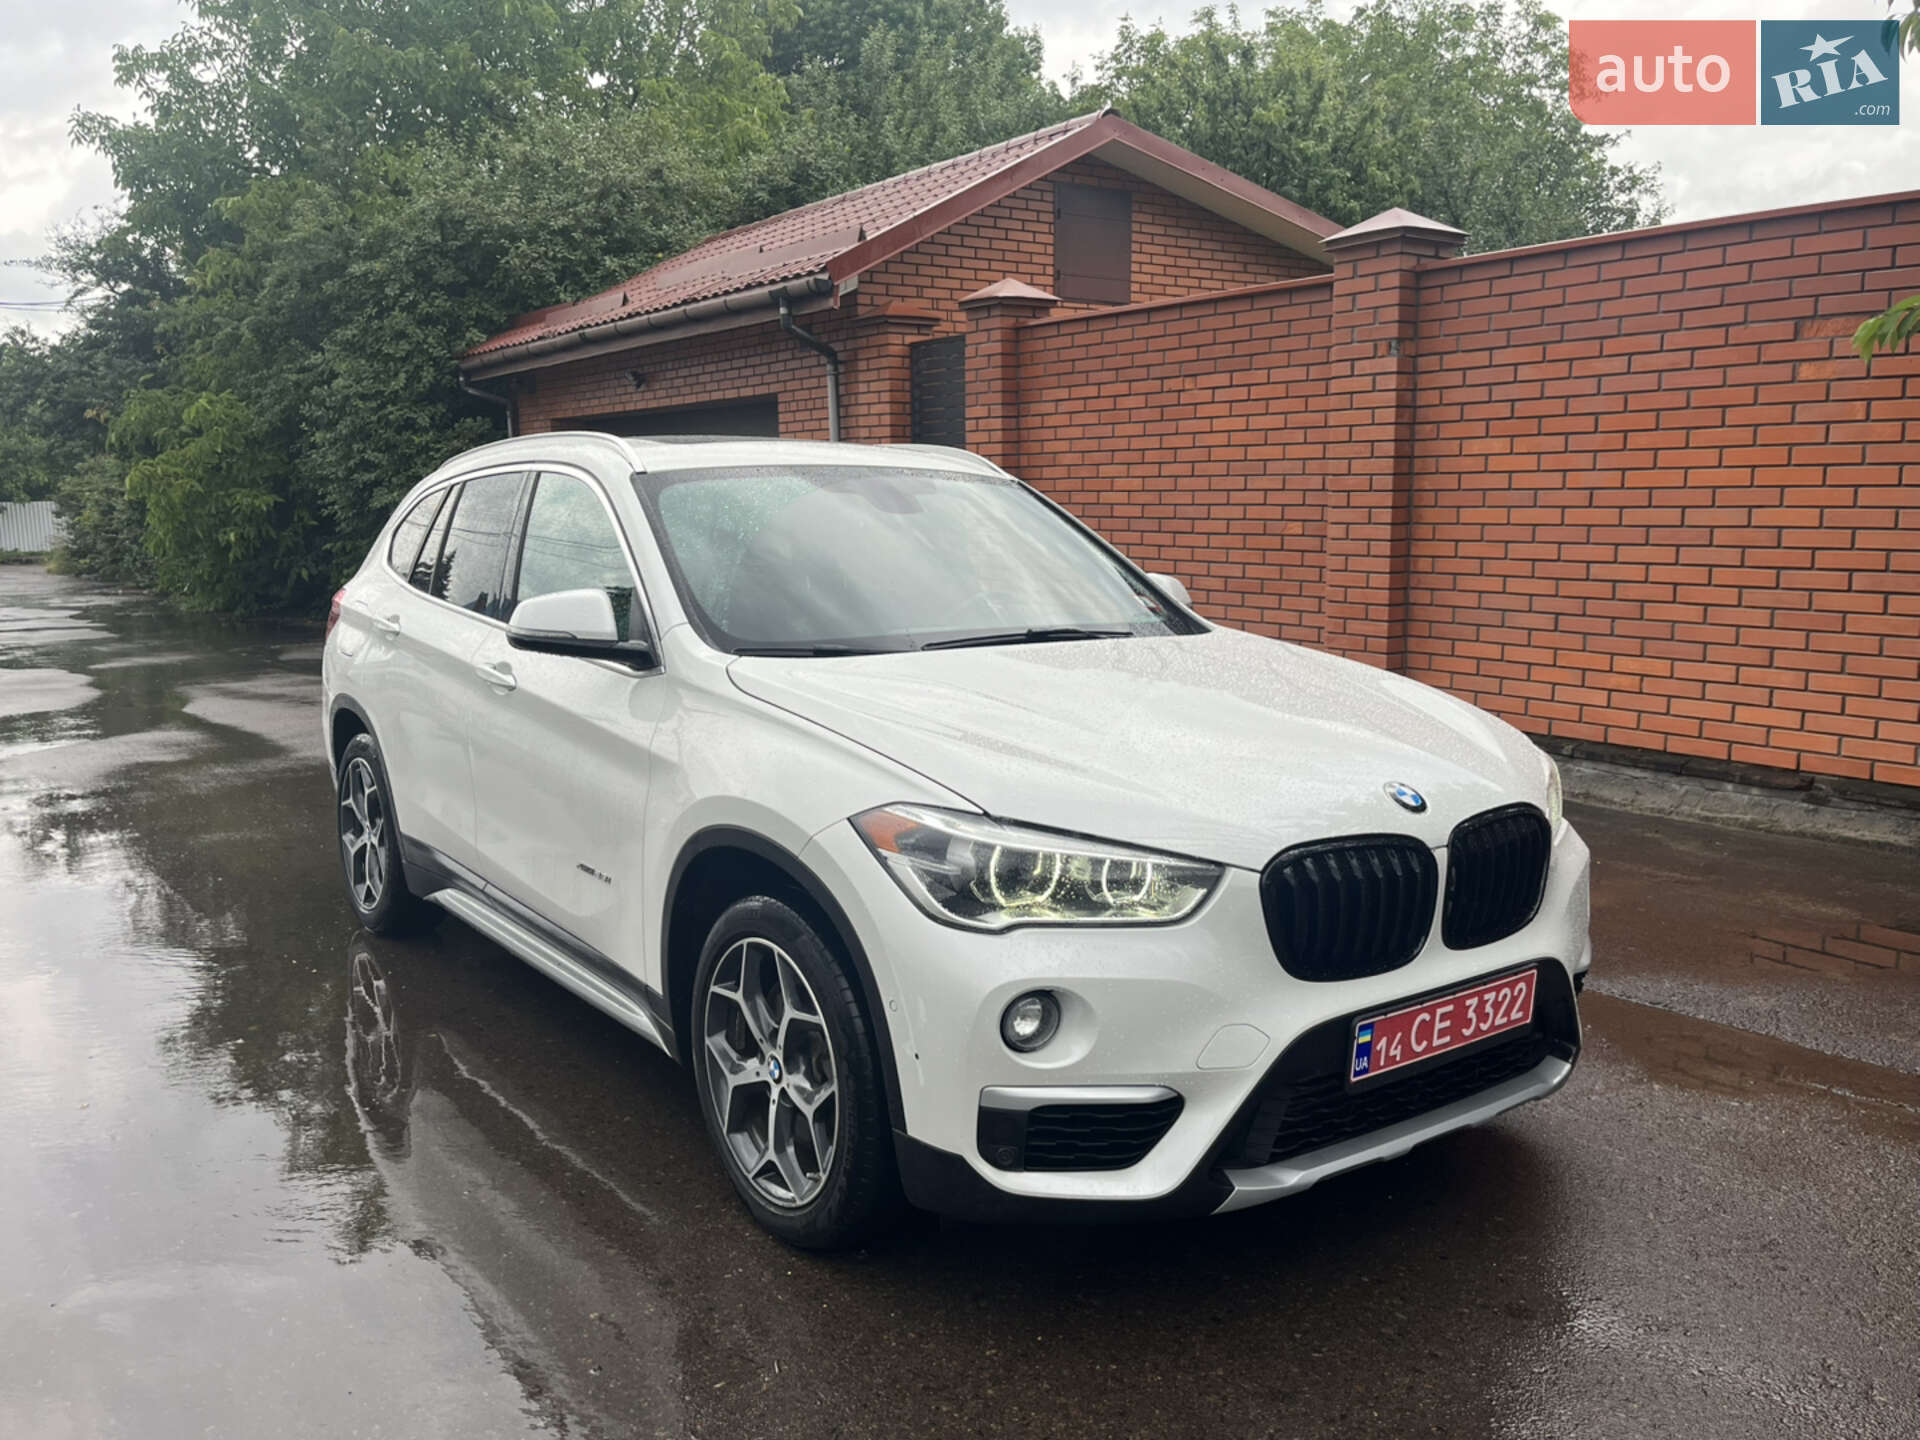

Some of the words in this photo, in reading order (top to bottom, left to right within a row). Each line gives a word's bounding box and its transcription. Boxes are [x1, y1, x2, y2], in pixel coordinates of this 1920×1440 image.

[1376, 1032, 1402, 1066] 14
[1411, 1005, 1454, 1053] CE
[1461, 982, 1527, 1036] 3322
[1355, 1057, 1369, 1071] UA
